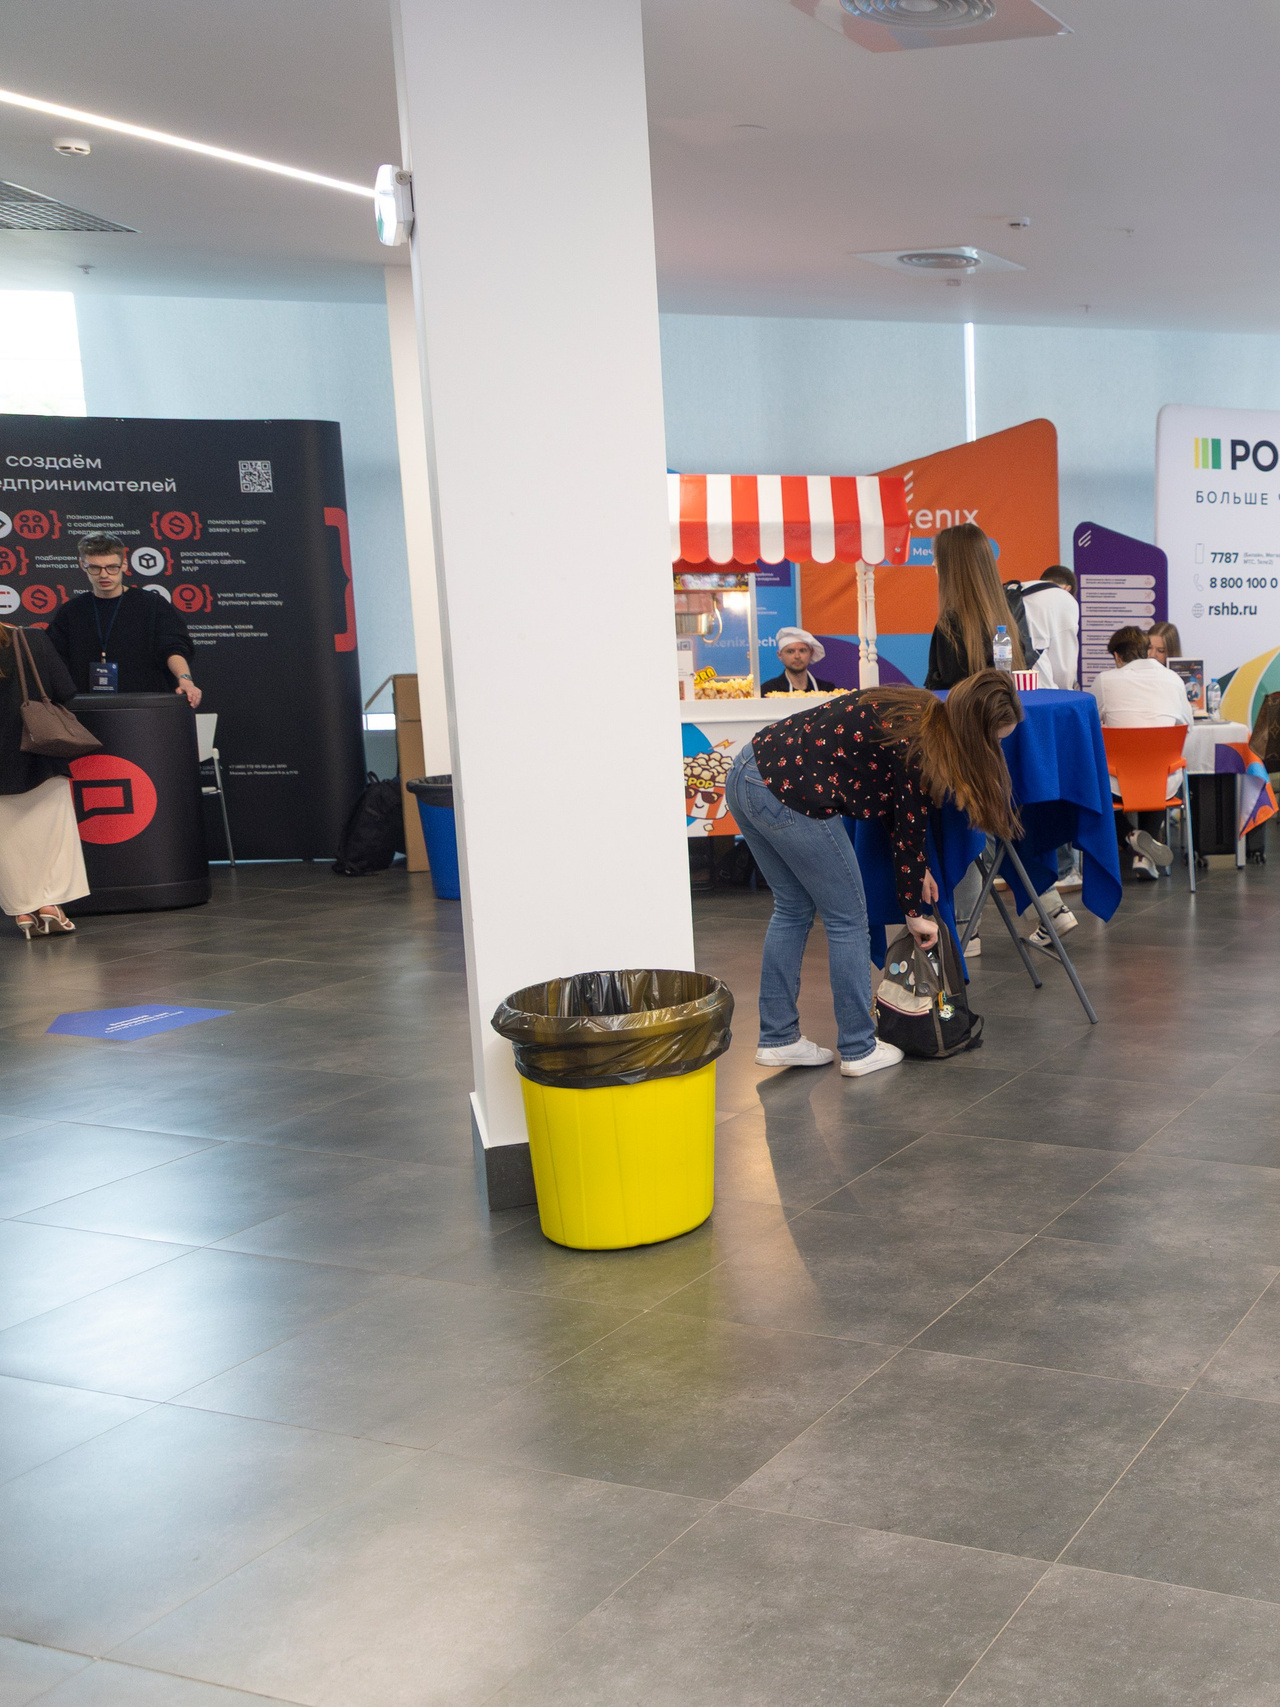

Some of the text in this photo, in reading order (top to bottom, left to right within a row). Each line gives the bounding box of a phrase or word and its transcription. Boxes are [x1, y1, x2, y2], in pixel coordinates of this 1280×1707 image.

[6, 453, 102, 470] создаём
[0, 477, 177, 494] дпринимателей
[1196, 490, 1269, 506] БОЛЬШЕ
[73, 521, 125, 529] сообществом
[907, 508, 979, 529] enix
[912, 547, 934, 556] Меч
[1210, 552, 1239, 564] 7787
[1209, 577, 1217, 589] 8
[1220, 577, 1243, 589] 800
[1246, 577, 1267, 589] 100
[1270, 577, 1278, 589] 0
[1208, 602, 1258, 616] rshb.ru
[687, 777, 715, 789] POP
